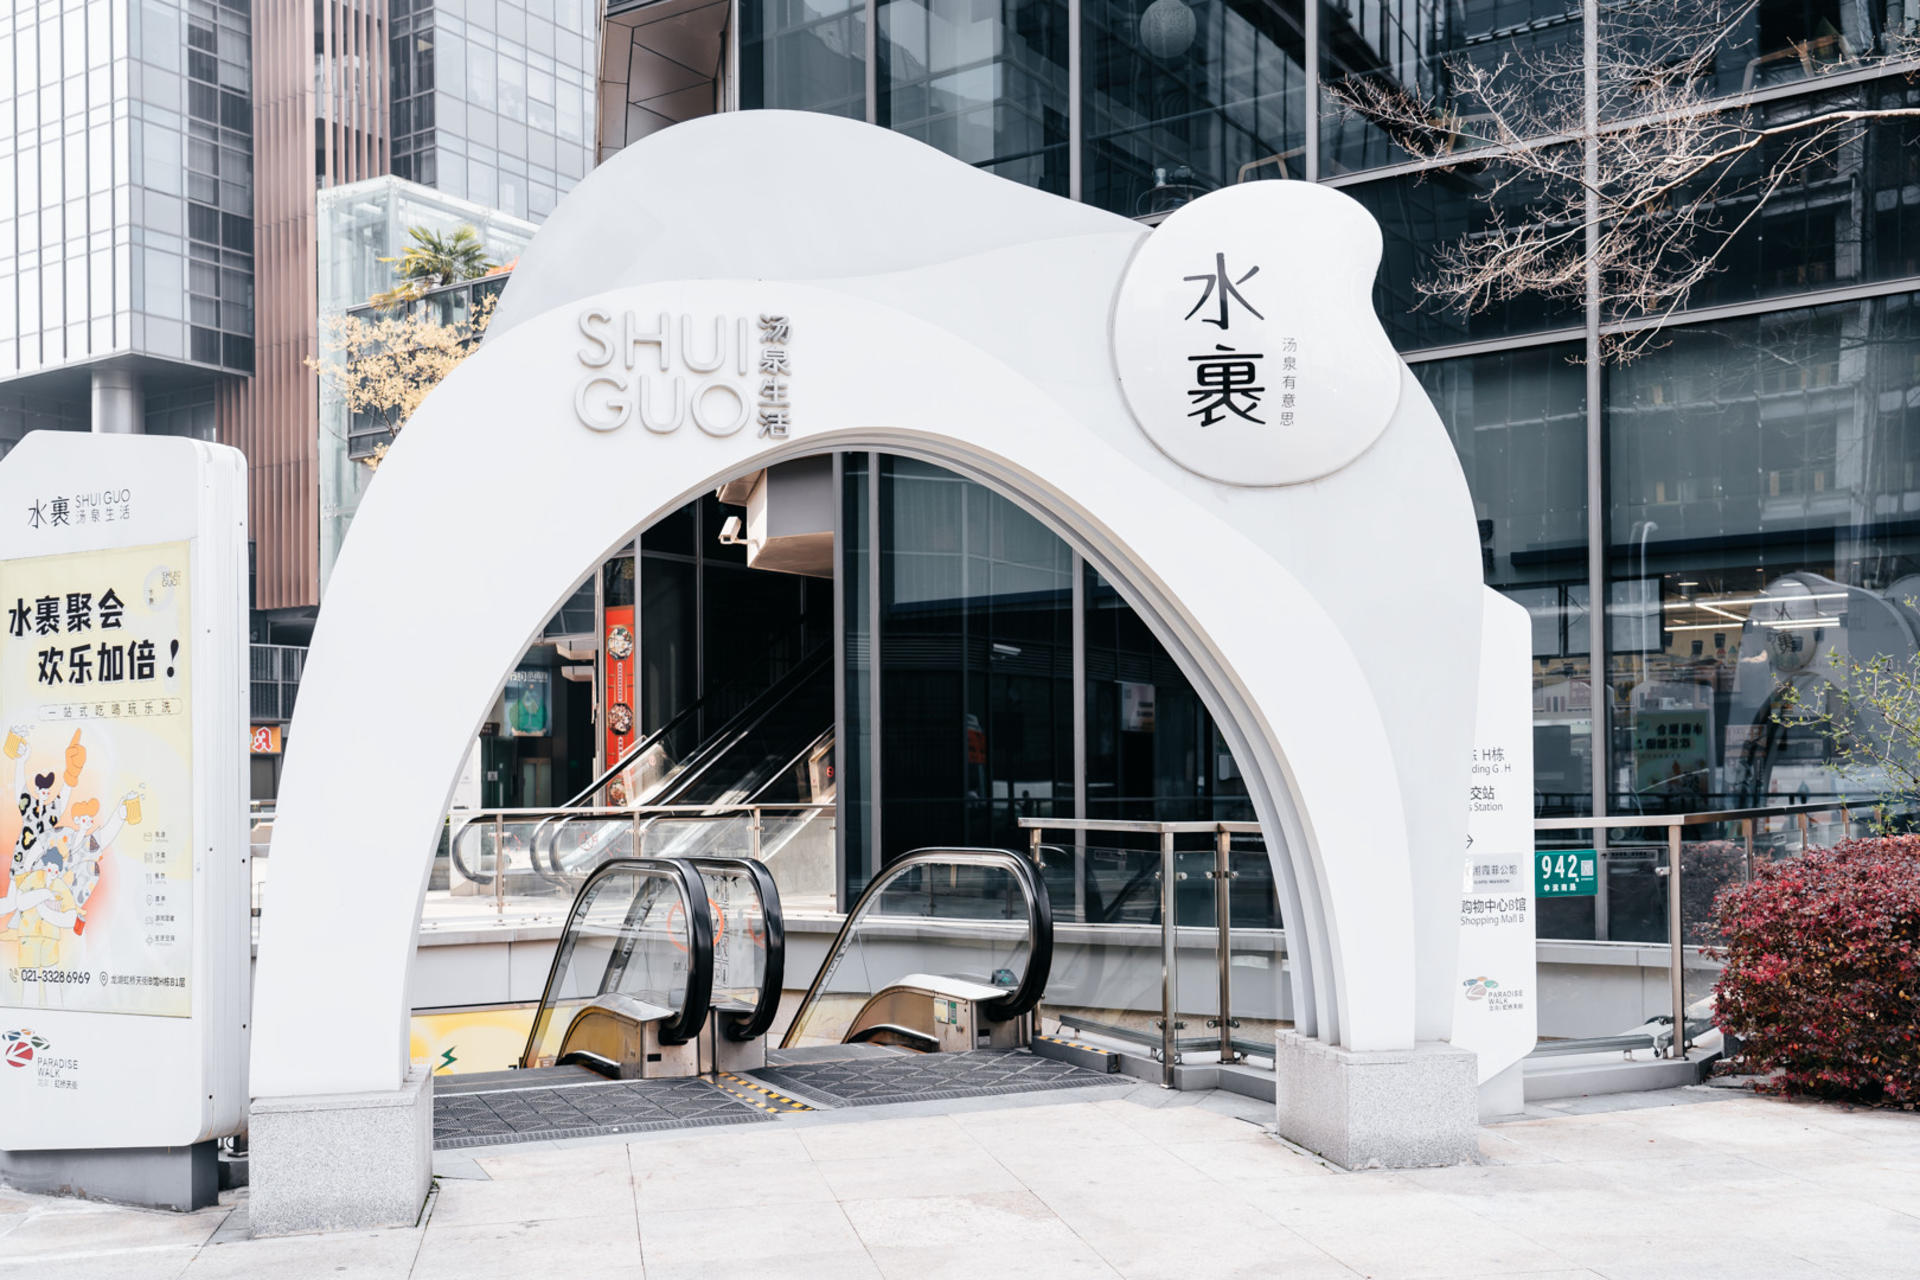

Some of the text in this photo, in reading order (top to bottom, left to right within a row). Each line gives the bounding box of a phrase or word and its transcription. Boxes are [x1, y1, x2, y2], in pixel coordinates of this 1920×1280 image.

[577, 308, 748, 377] SHUI
[1183, 252, 1266, 427] 水裹
[757, 313, 792, 440] 汤泉生活
[1280, 337, 1298, 427] 汤泉有意思
[574, 373, 751, 439] GUO
[75, 488, 131, 508] SHUI GUO
[27, 496, 71, 529] 水裹
[76, 504, 130, 524] 汤泉生活
[8, 588, 124, 637] 水裹聚会
[1474, 802, 1503, 812] Station
[1541, 854, 1578, 879] 942
[1460, 915, 1499, 927] Shopping
[1501, 913, 1518, 923] Mall
[21, 968, 91, 985] 021-33286969
[1488, 989, 1524, 998] PARADISE
[38, 1057, 79, 1070] PARADISE
[38, 1067, 61, 1079] WALK
